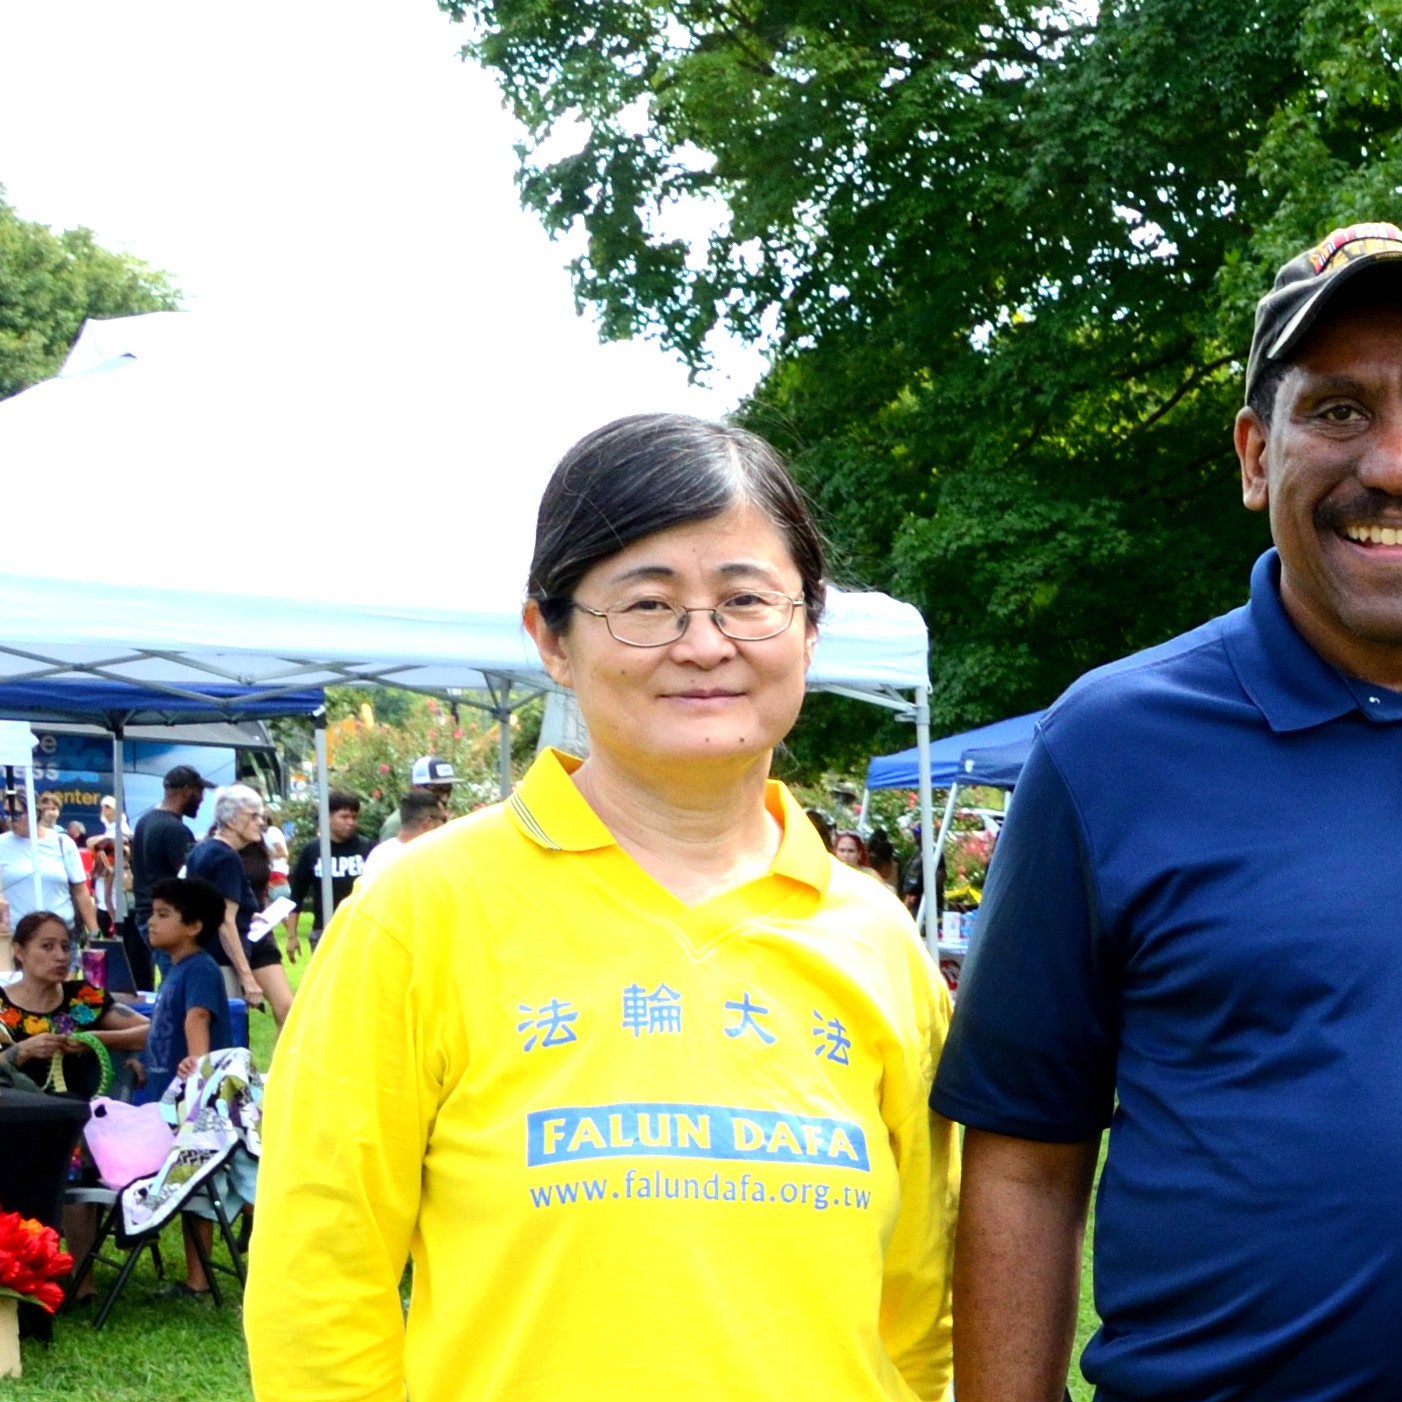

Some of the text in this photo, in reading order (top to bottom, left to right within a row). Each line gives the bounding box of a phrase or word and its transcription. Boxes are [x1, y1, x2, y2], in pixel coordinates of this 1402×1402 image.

[517, 982, 852, 1066] 法輪大法
[542, 1113, 859, 1162] FALUN DAFA
[530, 1169, 872, 1211] www.falundafa.org.tw
